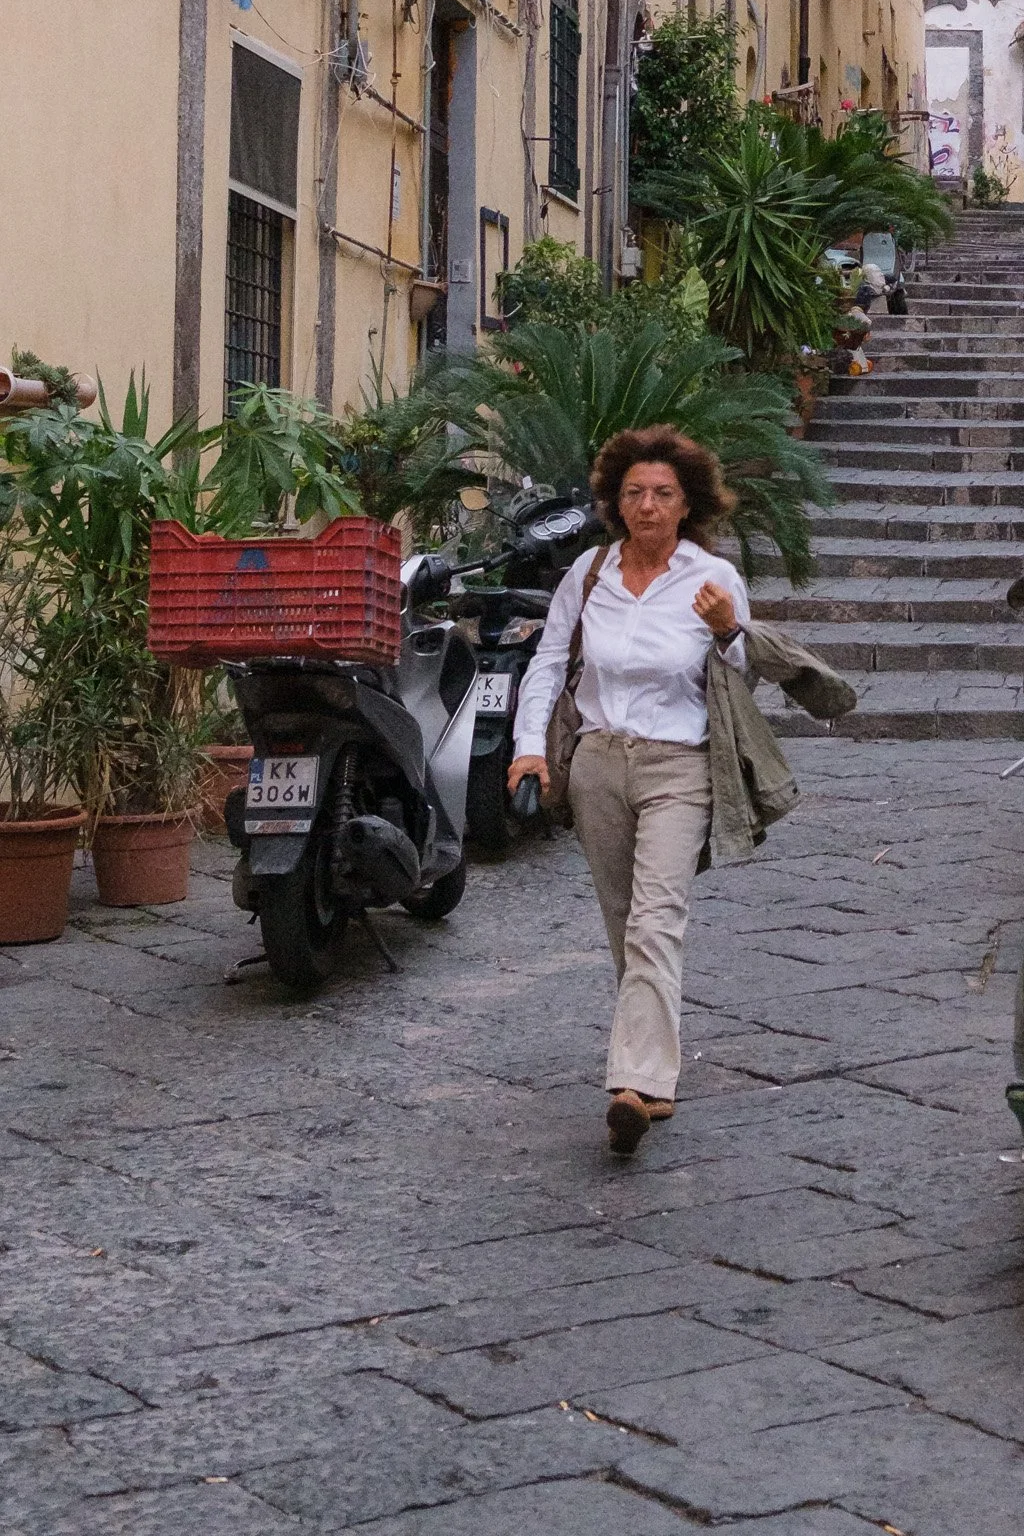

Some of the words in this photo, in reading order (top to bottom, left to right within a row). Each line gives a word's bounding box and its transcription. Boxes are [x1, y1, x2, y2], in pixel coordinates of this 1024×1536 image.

[477, 695, 503, 708] 5X
[250, 773, 262, 782] PL
[269, 761, 298, 780] KK
[252, 785, 310, 803] 306W
